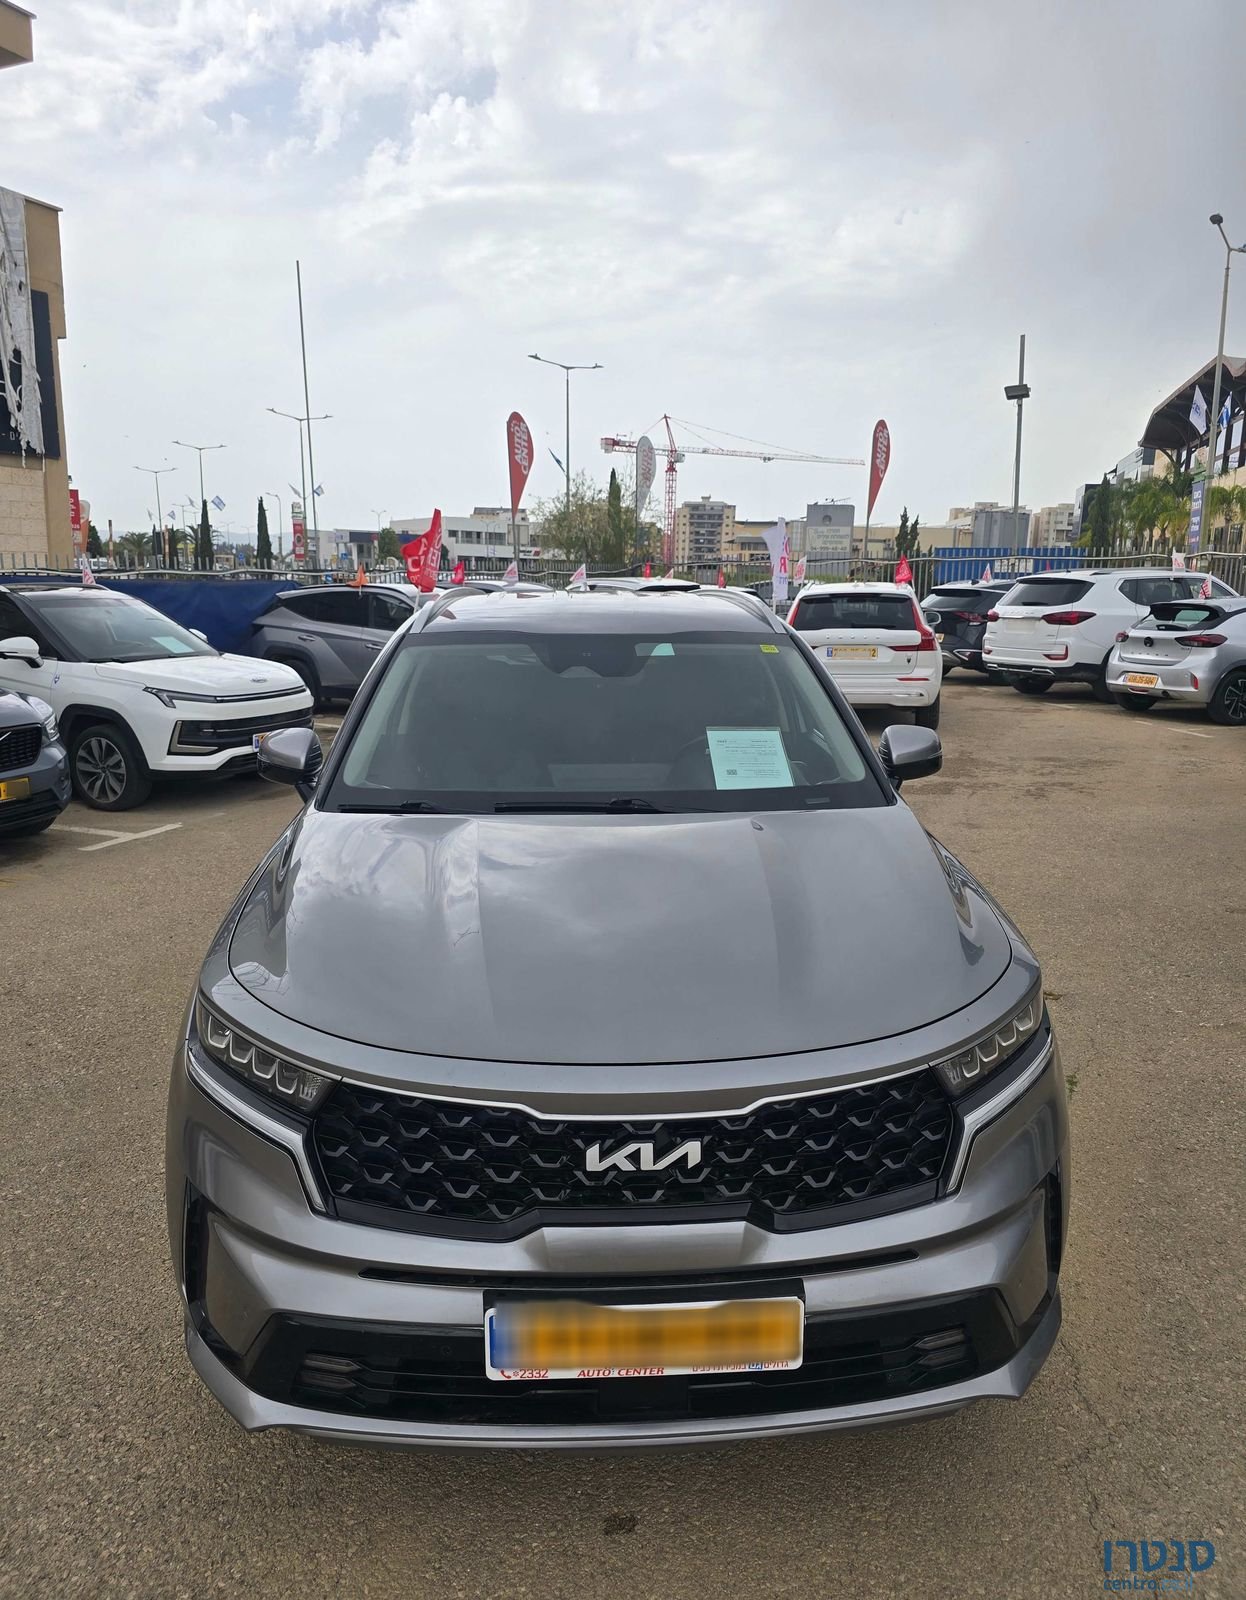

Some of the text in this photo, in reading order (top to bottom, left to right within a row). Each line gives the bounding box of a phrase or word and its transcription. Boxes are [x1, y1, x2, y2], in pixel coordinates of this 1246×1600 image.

[514, 428, 522, 464] AUTO
[521, 422, 529, 475] CENTER
[585, 1141, 702, 1171] KIA
[577, 1365, 665, 1378] AUTO CENTER
